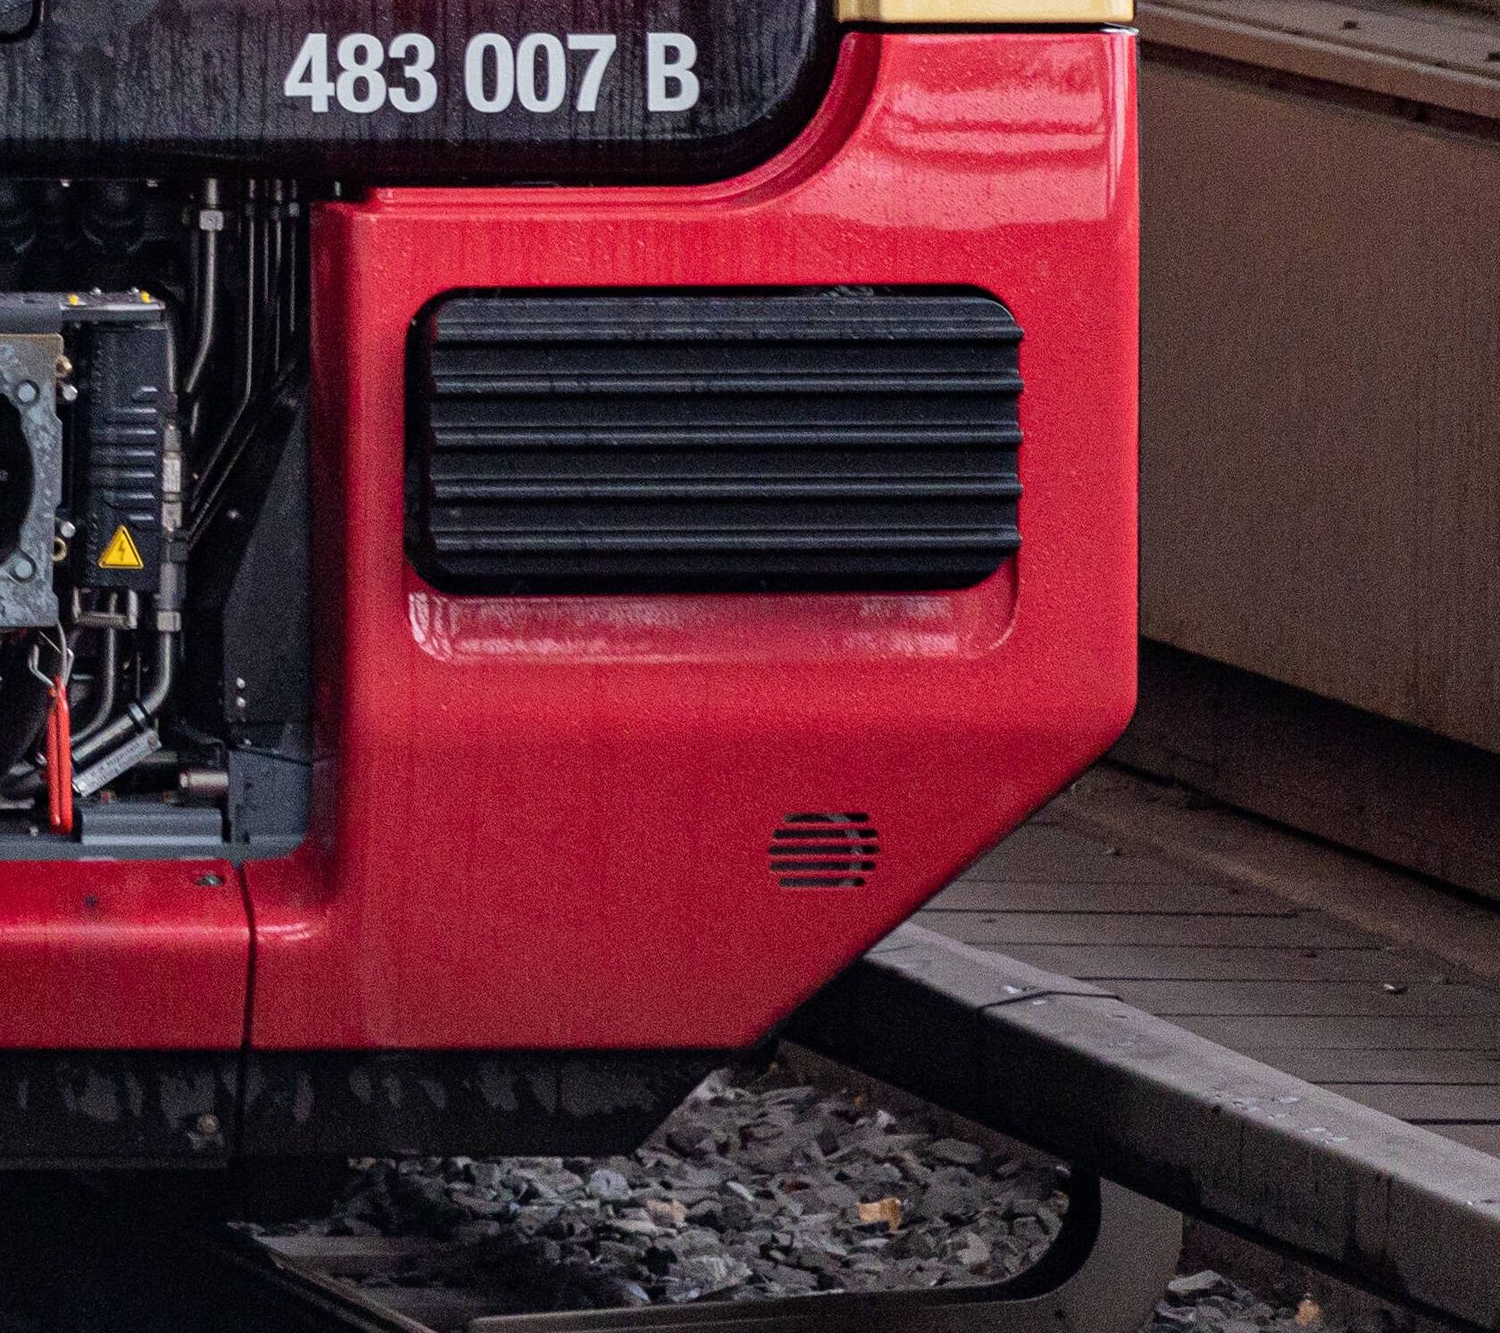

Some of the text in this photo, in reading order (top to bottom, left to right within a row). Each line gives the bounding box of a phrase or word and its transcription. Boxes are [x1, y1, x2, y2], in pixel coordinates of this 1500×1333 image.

[284, 32, 700, 114] 483 007 B
